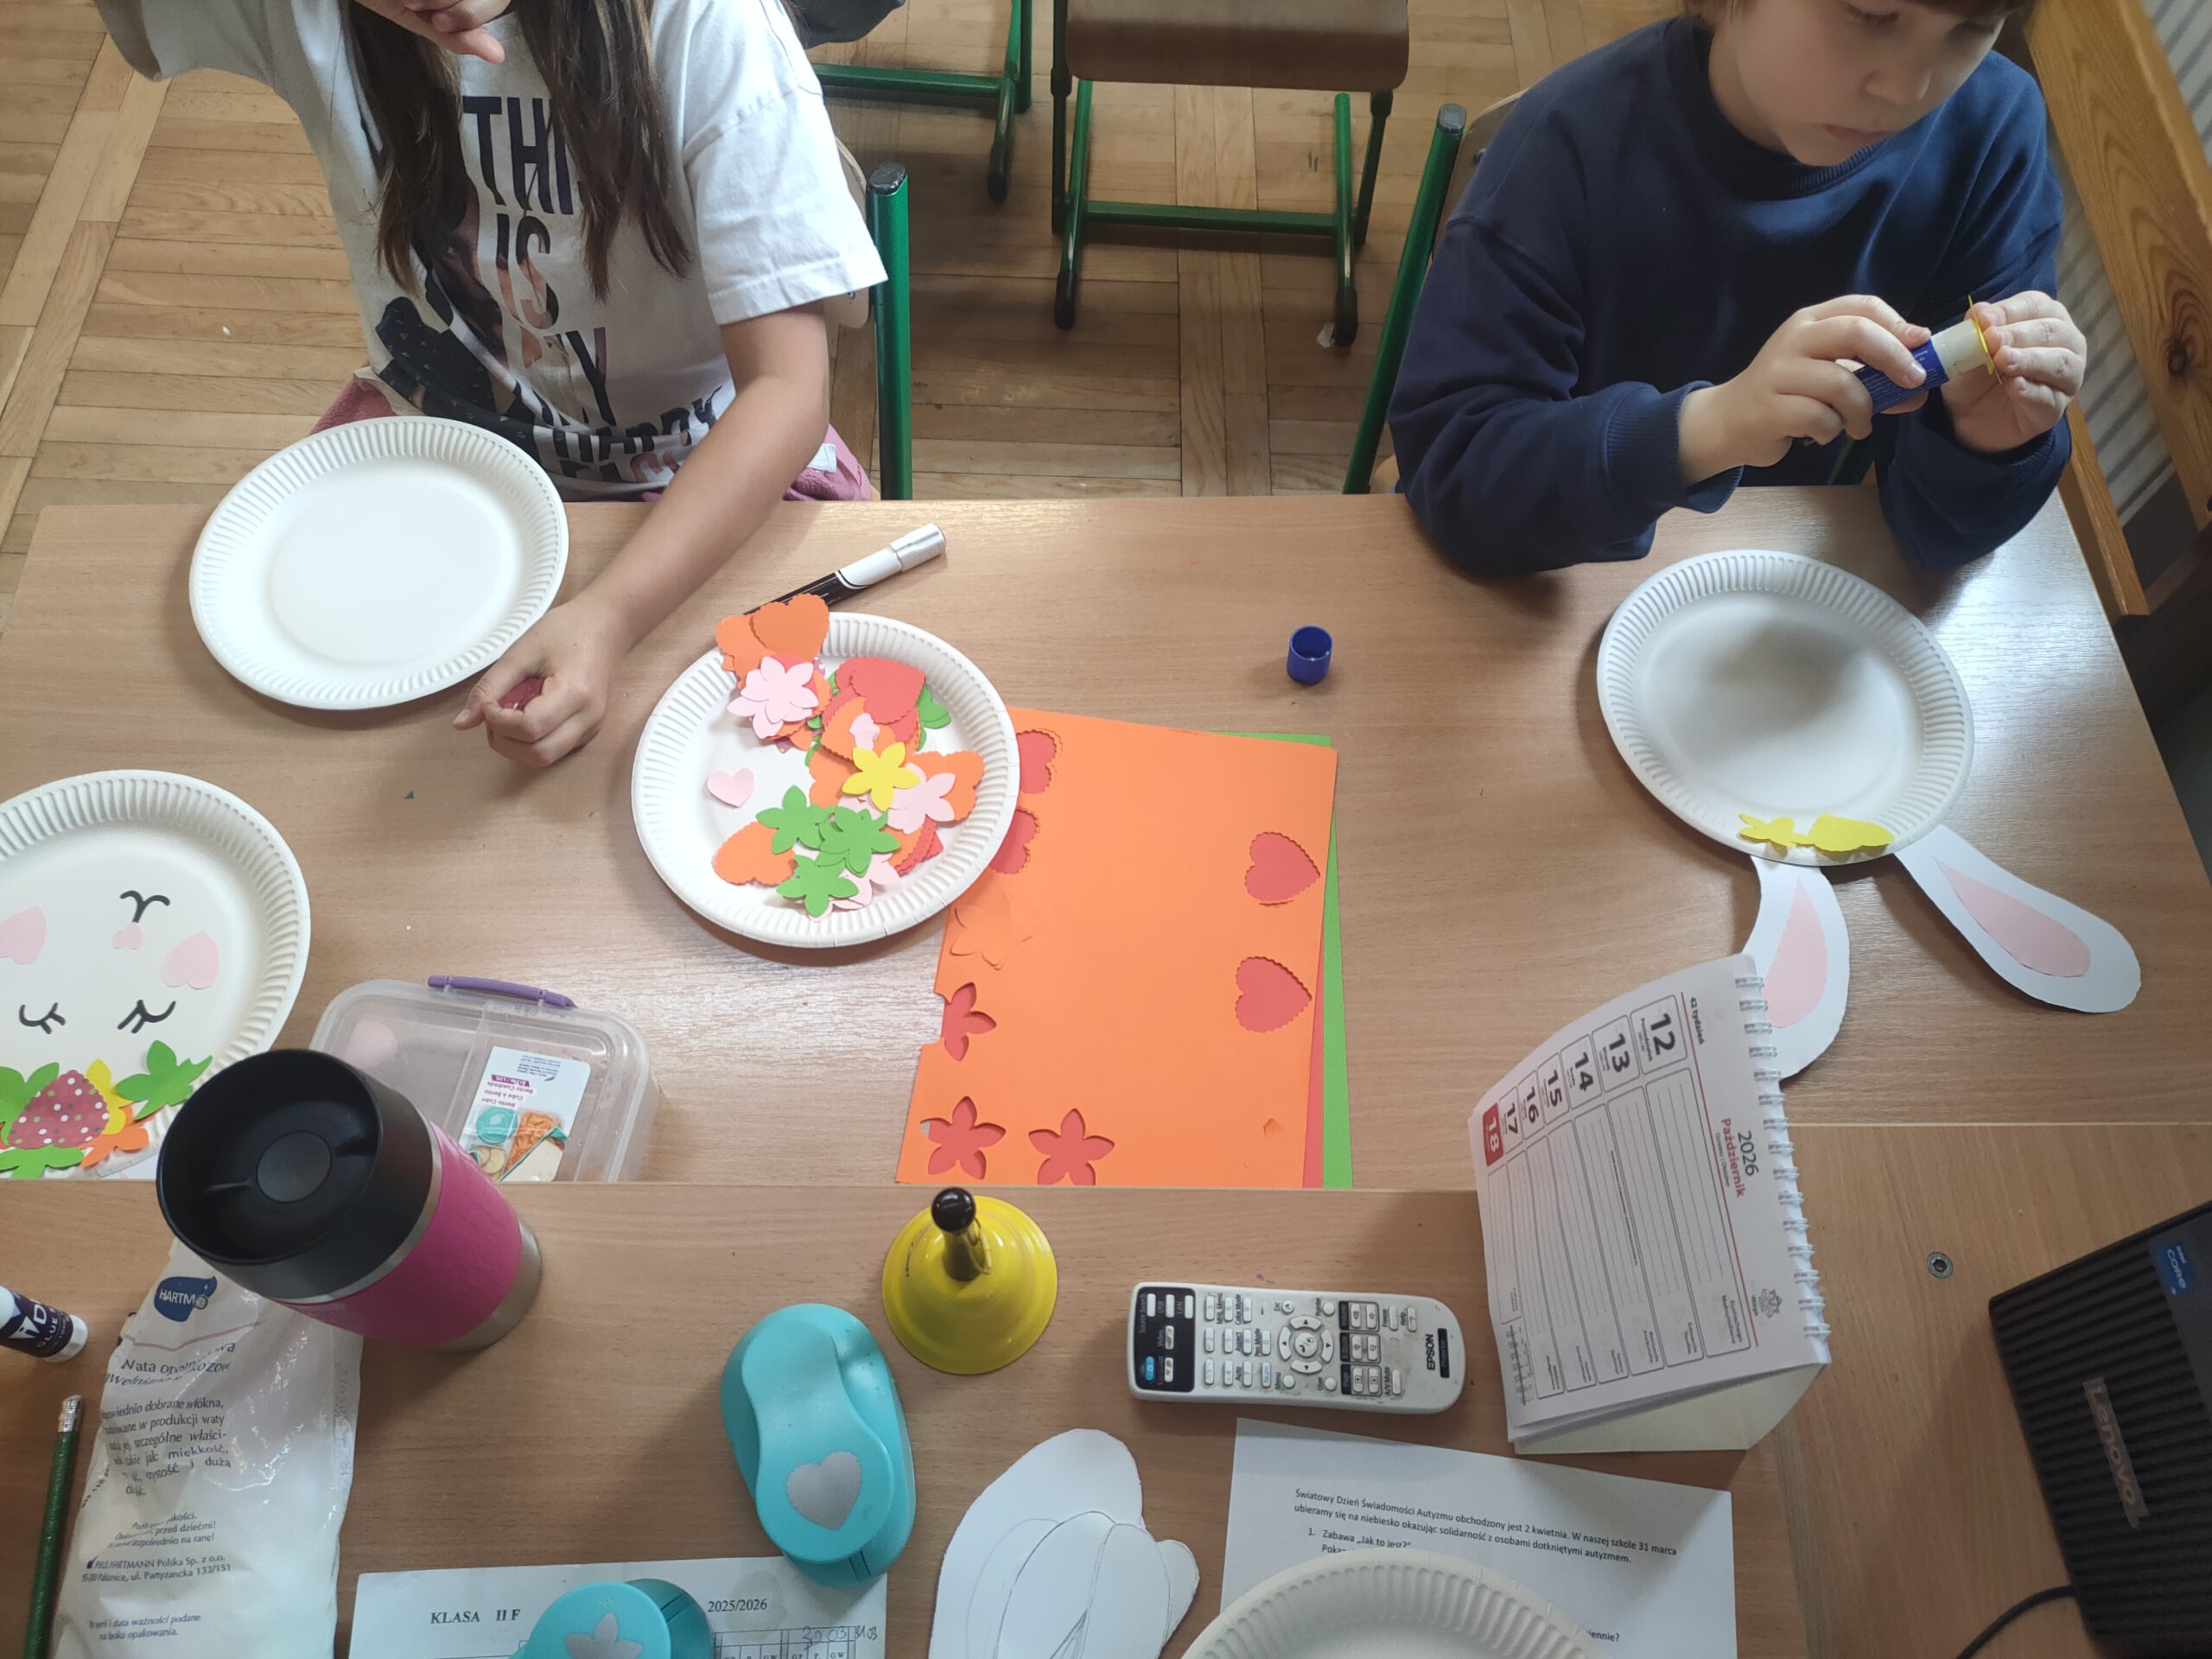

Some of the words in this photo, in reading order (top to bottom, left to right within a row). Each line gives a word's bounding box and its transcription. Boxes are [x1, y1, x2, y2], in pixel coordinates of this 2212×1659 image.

[463, 96, 584, 215] THI
[495, 213, 559, 329] IS
[1609, 1033, 1630, 1072] 13
[1650, 1013, 1676, 1056] 12
[1547, 1069, 1563, 1108] 15
[1574, 1052, 1594, 1092] 14
[1506, 1102, 1519, 1135] 17
[1526, 1085, 1540, 1124] 16
[1486, 1116, 1499, 1153] 18
[1738, 1129, 1759, 1177] 2026
[1721, 1117, 1746, 1198] Październik
[1425, 1333, 1436, 1371] EPSON
[149, 1414, 199, 1432] produkcji
[202, 1415, 225, 1427] waty
[2092, 1385, 2136, 1505] Lenovo
[155, 1525, 178, 1536] przed
[1294, 1488, 1335, 1505] Światowy
[1336, 1495, 1359, 1507] Dzień
[1361, 1499, 1415, 1516] Świadomości
[1416, 1508, 1453, 1522] Autyzmu
[1455, 1514, 1506, 1531] obchodzony
[1507, 1522, 1522, 1532] jest
[1524, 1524, 1530, 1533] 2
[1532, 1524, 1570, 1539] kwietnia.
[1572, 1532, 1582, 1541] W
[1583, 1534, 1610, 1548] naszej
[1611, 1538, 1637, 1550] szkole
[1637, 1541, 1649, 1551] 31
[1651, 1545, 1677, 1556] marca
[1294, 1504, 1333, 1519] ubieramy
[1334, 1512, 1347, 1522] się
[1361, 1515, 1400, 1528] niebiesko
[1402, 1521, 1438, 1535] okazując
[1439, 1527, 1487, 1541] solidarność
[1494, 1535, 1531, 1548] osobami
[1532, 1540, 1583, 1556] dotkniętymi
[1585, 1548, 1632, 1564] autyzmem.
[1307, 1527, 1315, 1536] 1.
[1322, 1529, 1355, 1542] Zabawa
[1376, 1538, 1386, 1548] to
[130, 1572, 142, 1581] ul.
[143, 1570, 193, 1582] Partyzancka
[196, 1565, 231, 1576] 133/151
[156, 1558, 183, 1567] Polska
[185, 1558, 198, 1567] Sp.
[170, 1613, 201, 1624] podane
[430, 1611, 480, 1624] KLASA
[496, 1610, 507, 1621] II
[512, 1609, 521, 1621] F
[707, 1599, 767, 1612] 2025/2026
[127, 1627, 179, 1641] opakowania.
